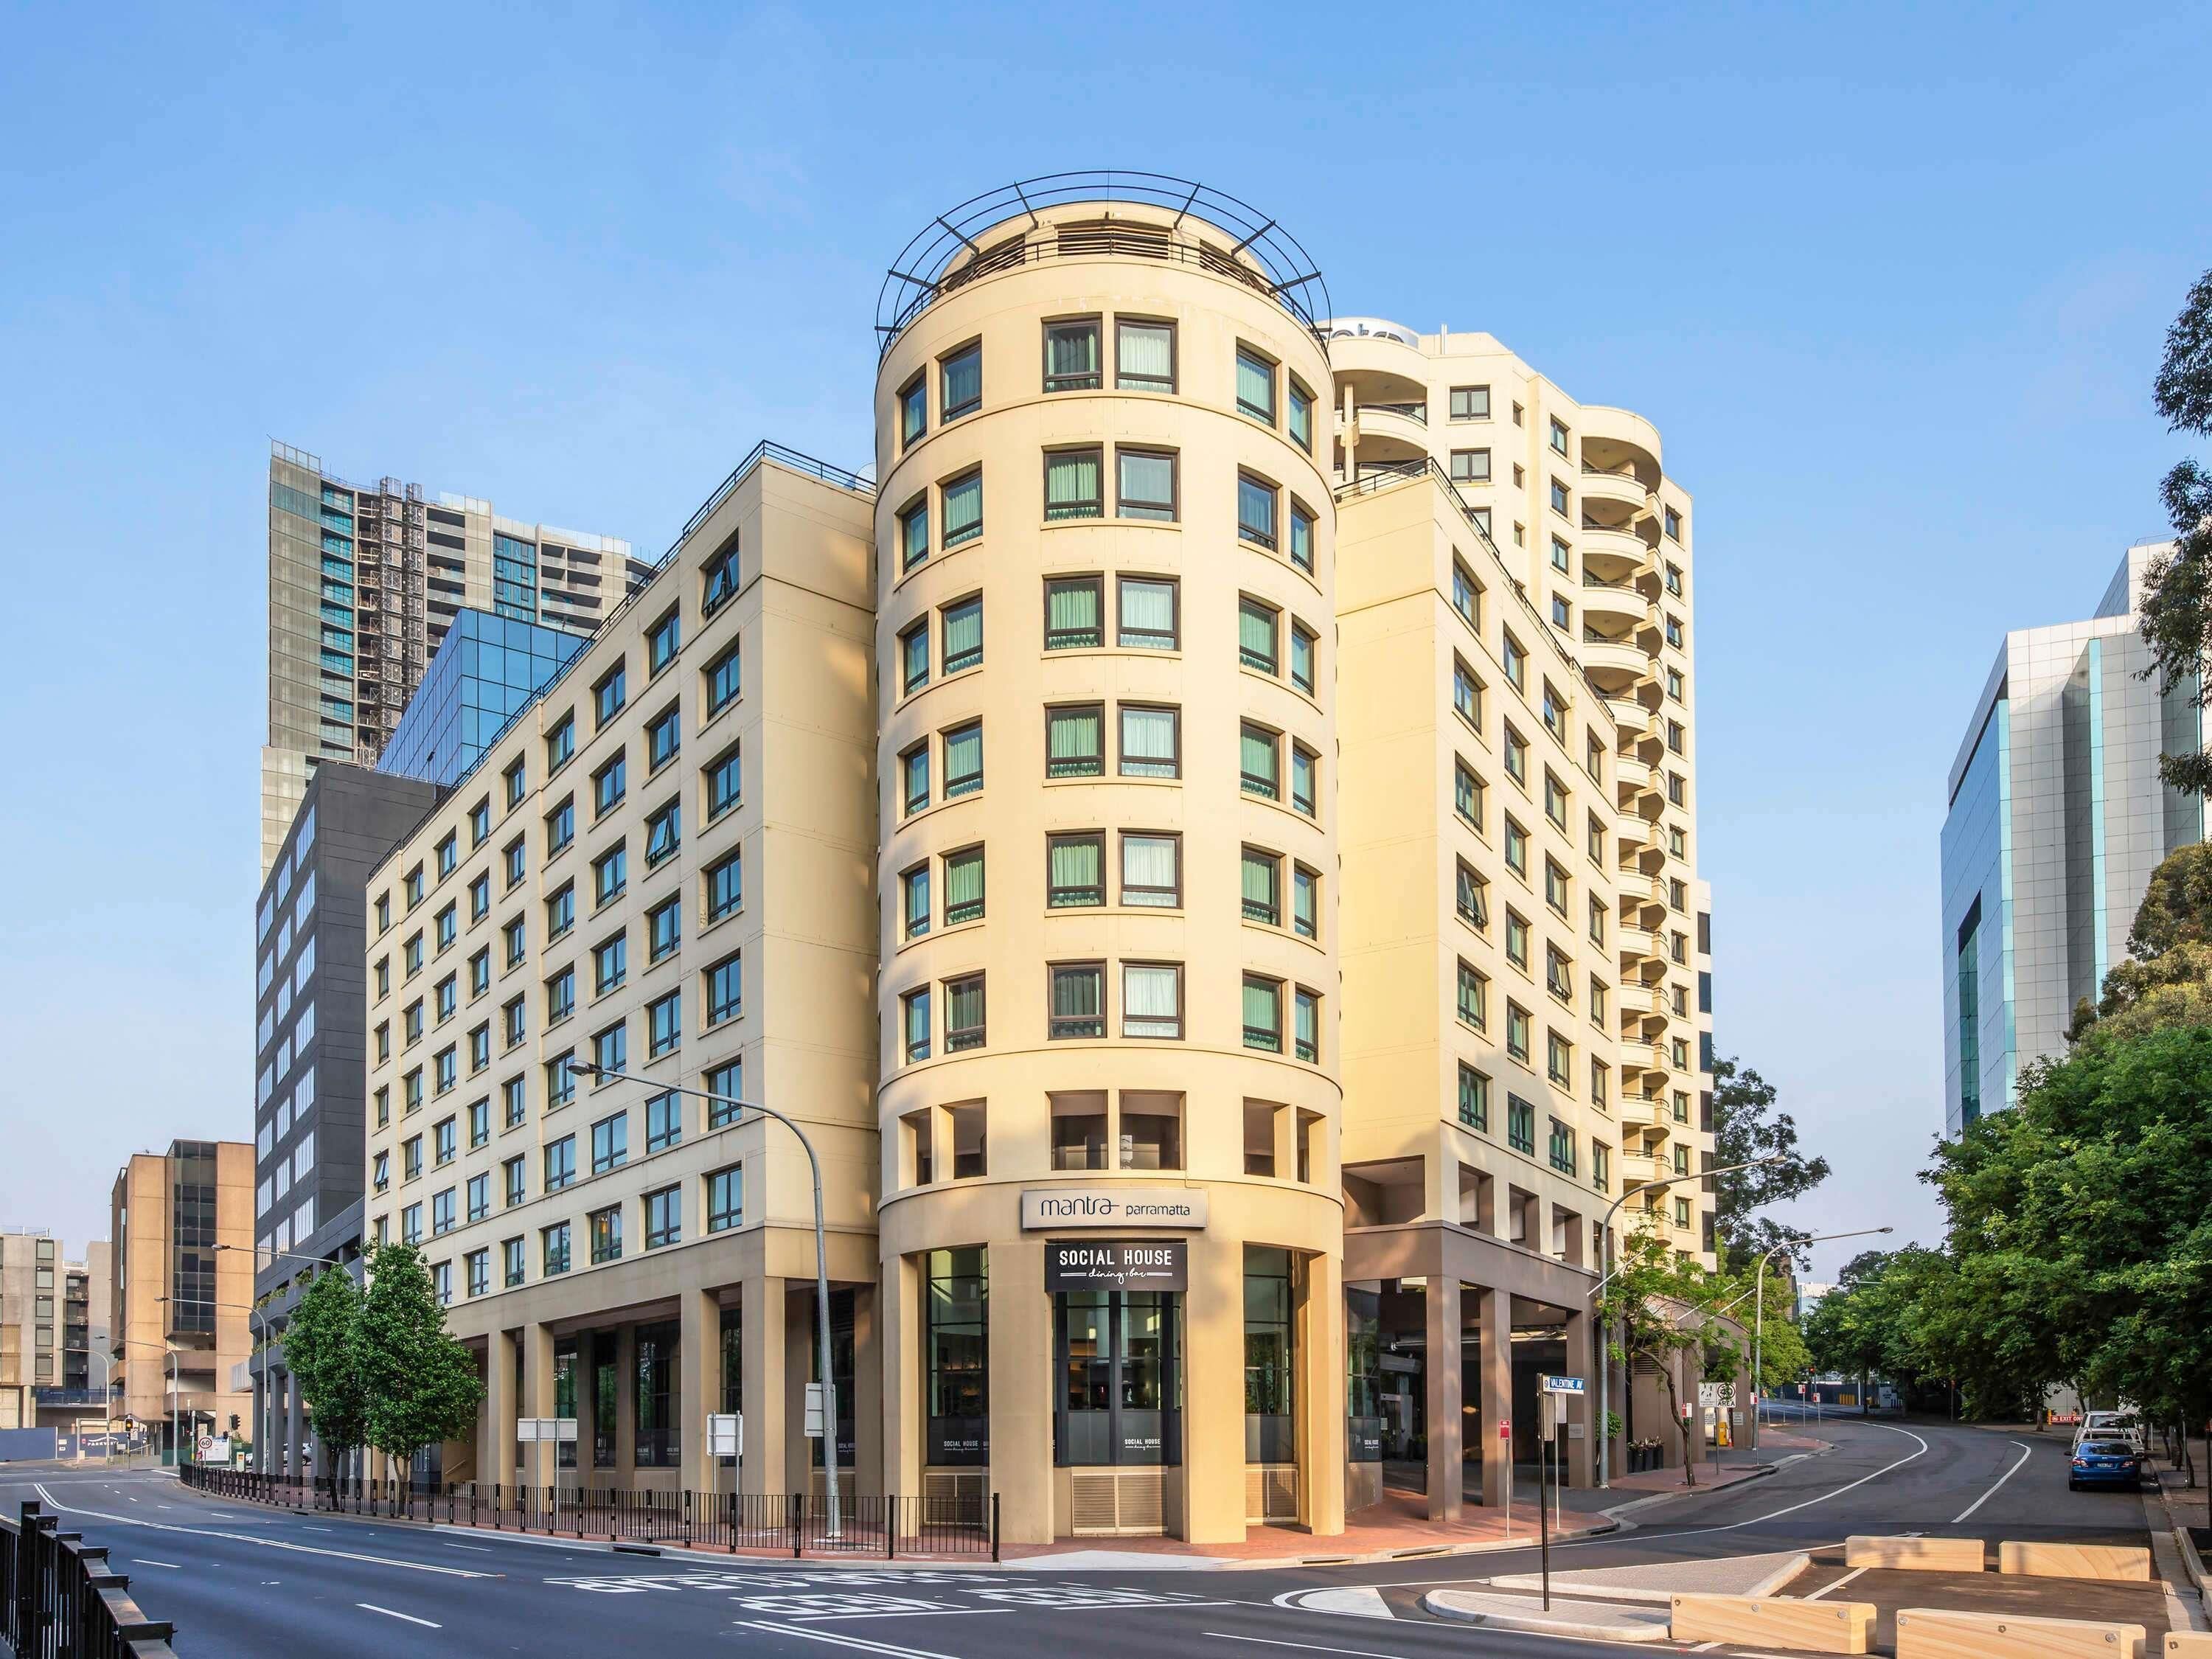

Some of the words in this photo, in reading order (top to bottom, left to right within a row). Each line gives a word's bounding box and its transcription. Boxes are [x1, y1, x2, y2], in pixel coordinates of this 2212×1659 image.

[1040, 1196, 1119, 1216] mantra
[1126, 1204, 1190, 1217] parramatta
[1059, 1250, 1115, 1265] SOCIAL
[1124, 1250, 1172, 1265] HOUSE
[1551, 1378, 1574, 1388] VALENTINE
